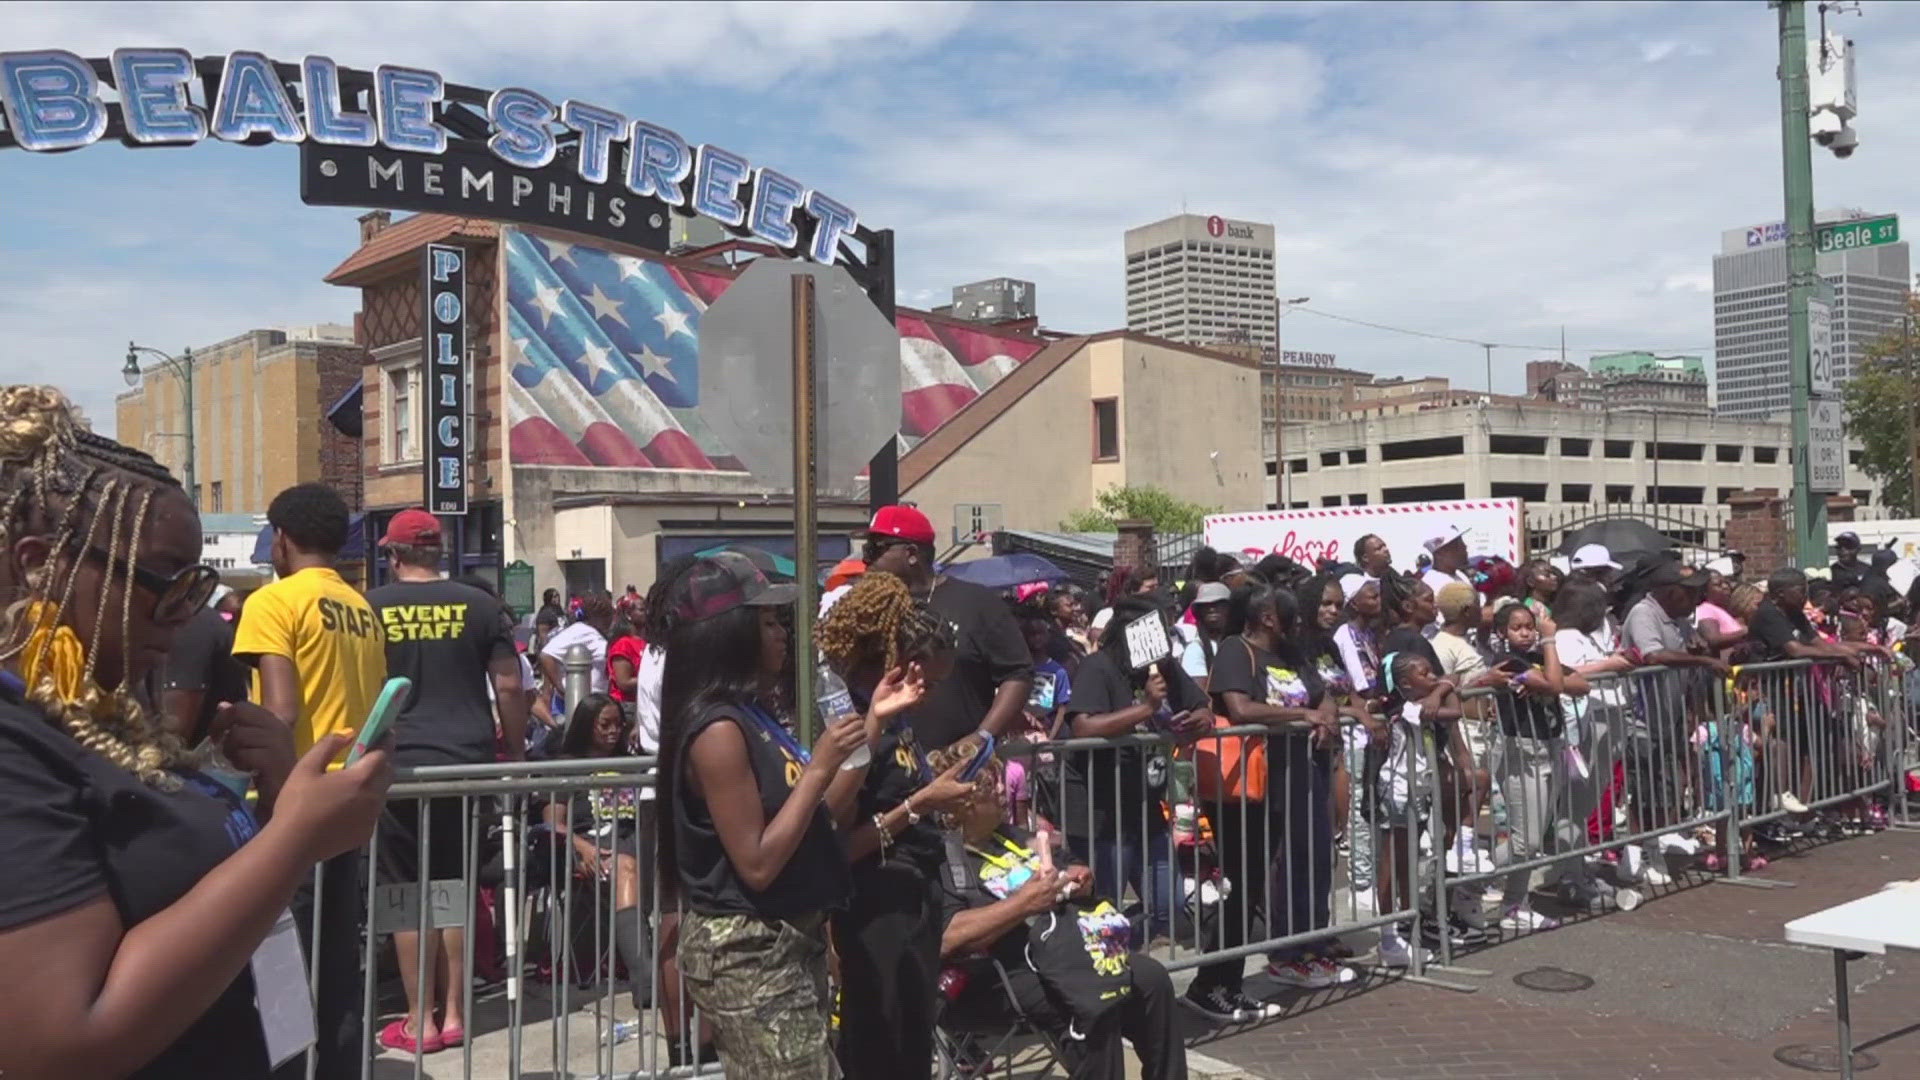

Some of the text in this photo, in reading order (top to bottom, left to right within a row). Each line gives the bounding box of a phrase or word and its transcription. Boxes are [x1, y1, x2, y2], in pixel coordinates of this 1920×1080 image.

[0, 47, 858, 265] BEALE STREET
[368, 155, 627, 228] MEMPHIS
[1227, 223, 1255, 240] bank
[1821, 225, 1894, 251] Beale ST
[432, 250, 461, 489] POLICE
[1283, 351, 1336, 366] PEABODY
[1813, 348, 1831, 382] 20
[1819, 405, 1831, 423] NO
[1810, 427, 1840, 442] TRUCKS
[1814, 465, 1840, 480] BUSES
[381, 603, 468, 625] EVENT
[387, 621, 465, 643] STAFF
